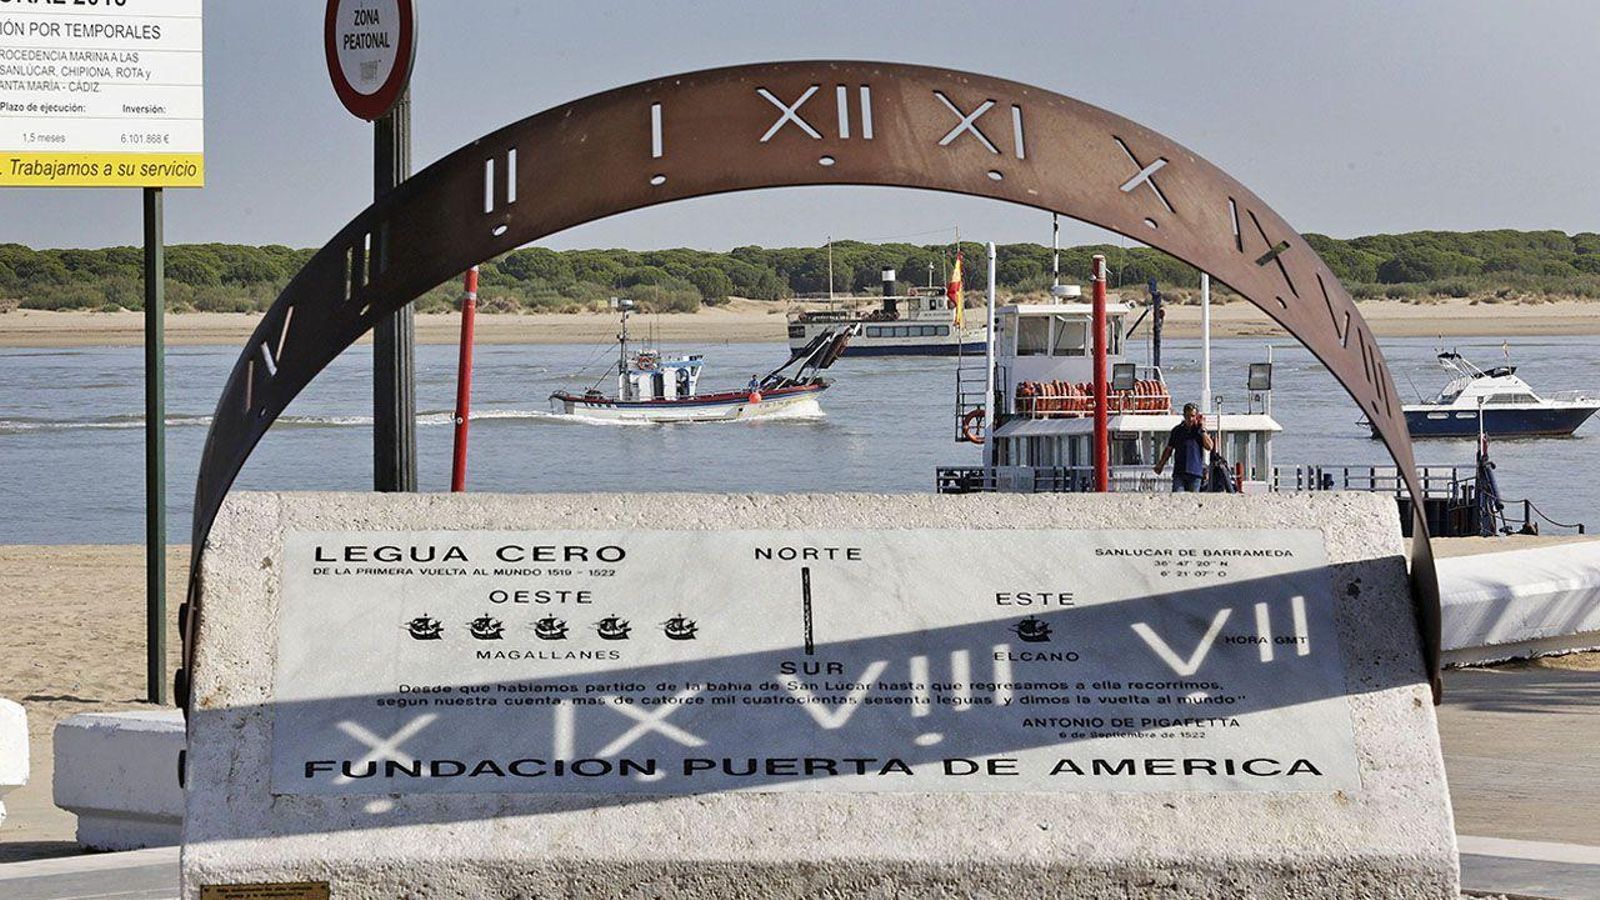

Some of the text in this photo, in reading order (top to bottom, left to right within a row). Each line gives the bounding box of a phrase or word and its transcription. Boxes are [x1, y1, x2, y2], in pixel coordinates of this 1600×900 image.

[354, 9, 379, 26] ZONA
[29, 22, 60, 37] POR
[64, 22, 161, 39] TEMPORALES
[343, 32, 390, 50] PEATONAL
[69, 51, 109, 62] MARINA
[110, 52, 118, 62] A
[120, 52, 139, 63] LAS
[61, 66, 113, 79] CHIPIONA,
[116, 67, 143, 78] ROTA
[145, 70, 152, 81] y
[27, 79, 60, 92] MARÍA
[0, 102, 86, 115] Plazo de ejecución:
[122, 104, 167, 114] Inversión:
[757, 84, 874, 143] XII
[932, 89, 1027, 160] XI
[37, 134, 66, 143] meses
[10, 158, 197, 180] Trabajamos a su servicio
[1112, 134, 1177, 214] X
[314, 545, 626, 562] LEGUA CERO
[754, 546, 862, 561] NORTE
[1095, 548, 1295, 557] SANLUCAR DE BARRAMEDA
[419, 568, 467, 576] VUELTA
[473, 568, 489, 576] AL
[494, 568, 542, 576] MUNDO
[589, 569, 616, 577] 1522
[489, 590, 593, 605] OESTE
[996, 592, 1075, 606] ESTE
[1225, 635, 1308, 645] HORA GMT
[476, 650, 621, 660] MAGALLANES
[994, 651, 1080, 663] ELCANO
[780, 661, 844, 675] SUR
[399, 684, 452, 694] Desde
[459, 684, 490, 695] que
[585, 683, 646, 693] partido
[656, 682, 677, 692] de
[685, 682, 701, 691] la
[759, 681, 781, 691] de
[787, 681, 818, 691] San
[825, 680, 871, 691] Lúcar
[878, 681, 925, 691] hasta
[931, 682, 963, 692] que
[968, 681, 1069, 692] regresamos
[1075, 682, 1086, 690] a
[1092, 680, 1121, 690] ella
[434, 696, 498, 706] nuestra
[572, 697, 606, 706] mas
[613, 695, 634, 705] de
[640, 696, 705, 706] catorce
[711, 695, 736, 705] mil
[742, 695, 858, 706] cuatrocientas
[864, 695, 931, 705] sesenta
[936, 695, 992, 707] leguas
[1003, 697, 1012, 706] y
[1019, 694, 1067, 705] dimos
[1076, 694, 1091, 705] la
[1099, 694, 1150, 705] vuelta
[1156, 694, 1171, 705] al
[1022, 717, 1240, 728] ANTONIO DE PIGAFETTA
[1089, 731, 1157, 739] Septiembre
[305, 758, 1324, 778] FUNDACION PUERTA DE AMERICA
